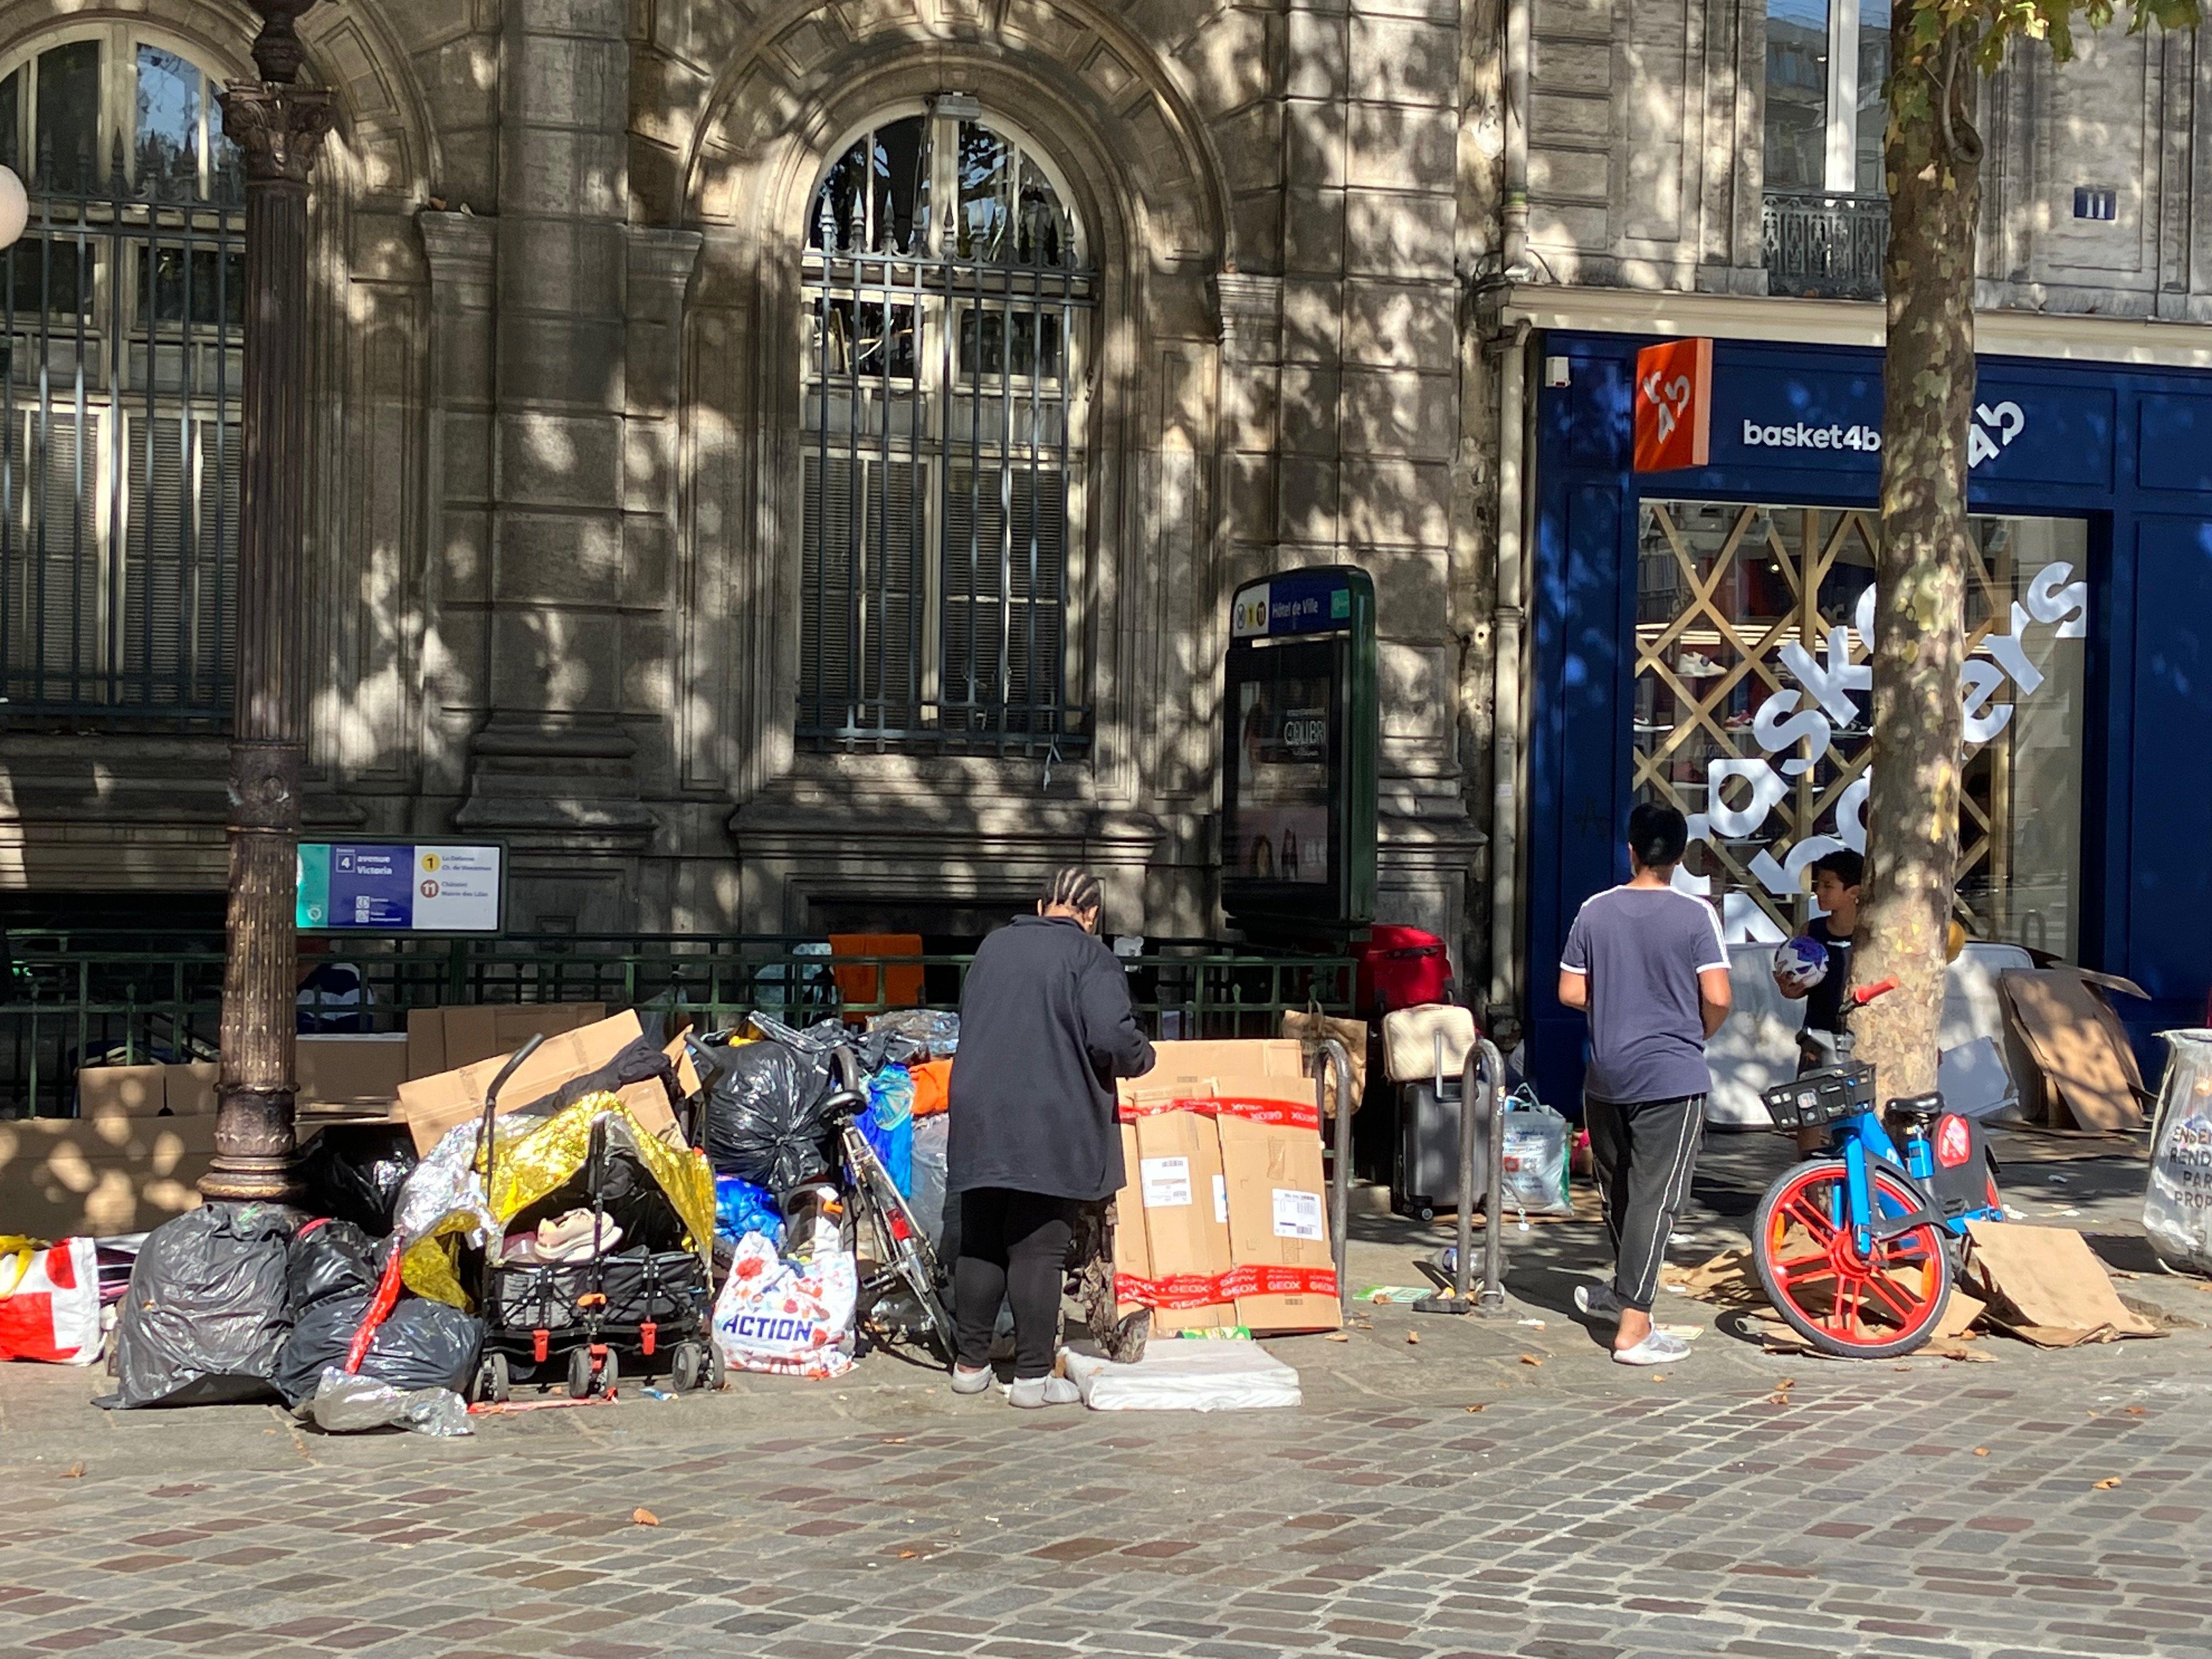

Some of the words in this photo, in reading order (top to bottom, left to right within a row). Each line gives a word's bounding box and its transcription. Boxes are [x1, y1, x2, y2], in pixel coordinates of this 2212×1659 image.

[2085, 192, 2106, 219] 11
[1743, 419, 1882, 452] basket4b
[341, 857, 351, 869] 4
[427, 857, 433, 870] 1
[357, 866, 393, 875] Victoria
[423, 883, 436, 895] 11
[2172, 1126, 2212, 1145] ENSE
[1220, 1283, 1259, 1297] GEOX
[1267, 1280, 1302, 1291] GEOX
[722, 1313, 814, 1342] ACTION
